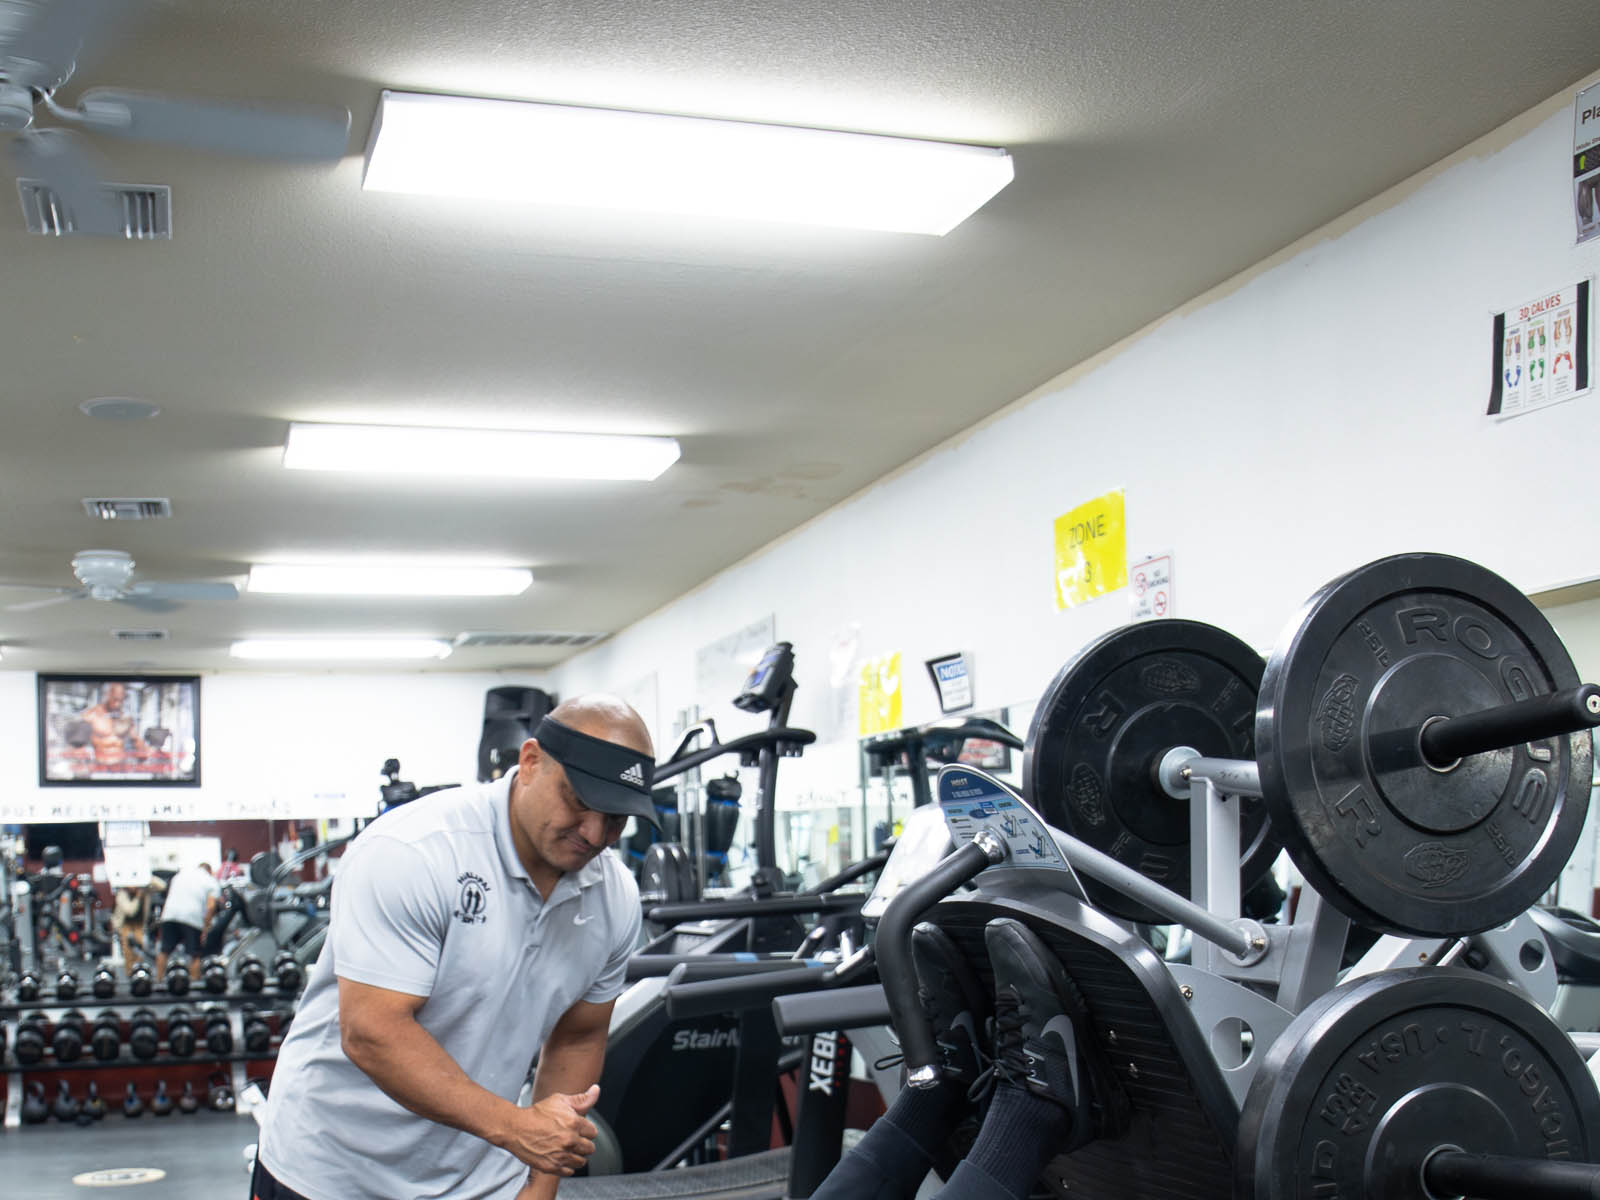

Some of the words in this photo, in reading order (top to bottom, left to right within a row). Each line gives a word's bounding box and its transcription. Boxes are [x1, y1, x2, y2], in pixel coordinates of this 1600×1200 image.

[1530, 293, 1561, 316] CALVES
[1068, 513, 1106, 549] ZONE
[620, 772, 645, 787] adidas
